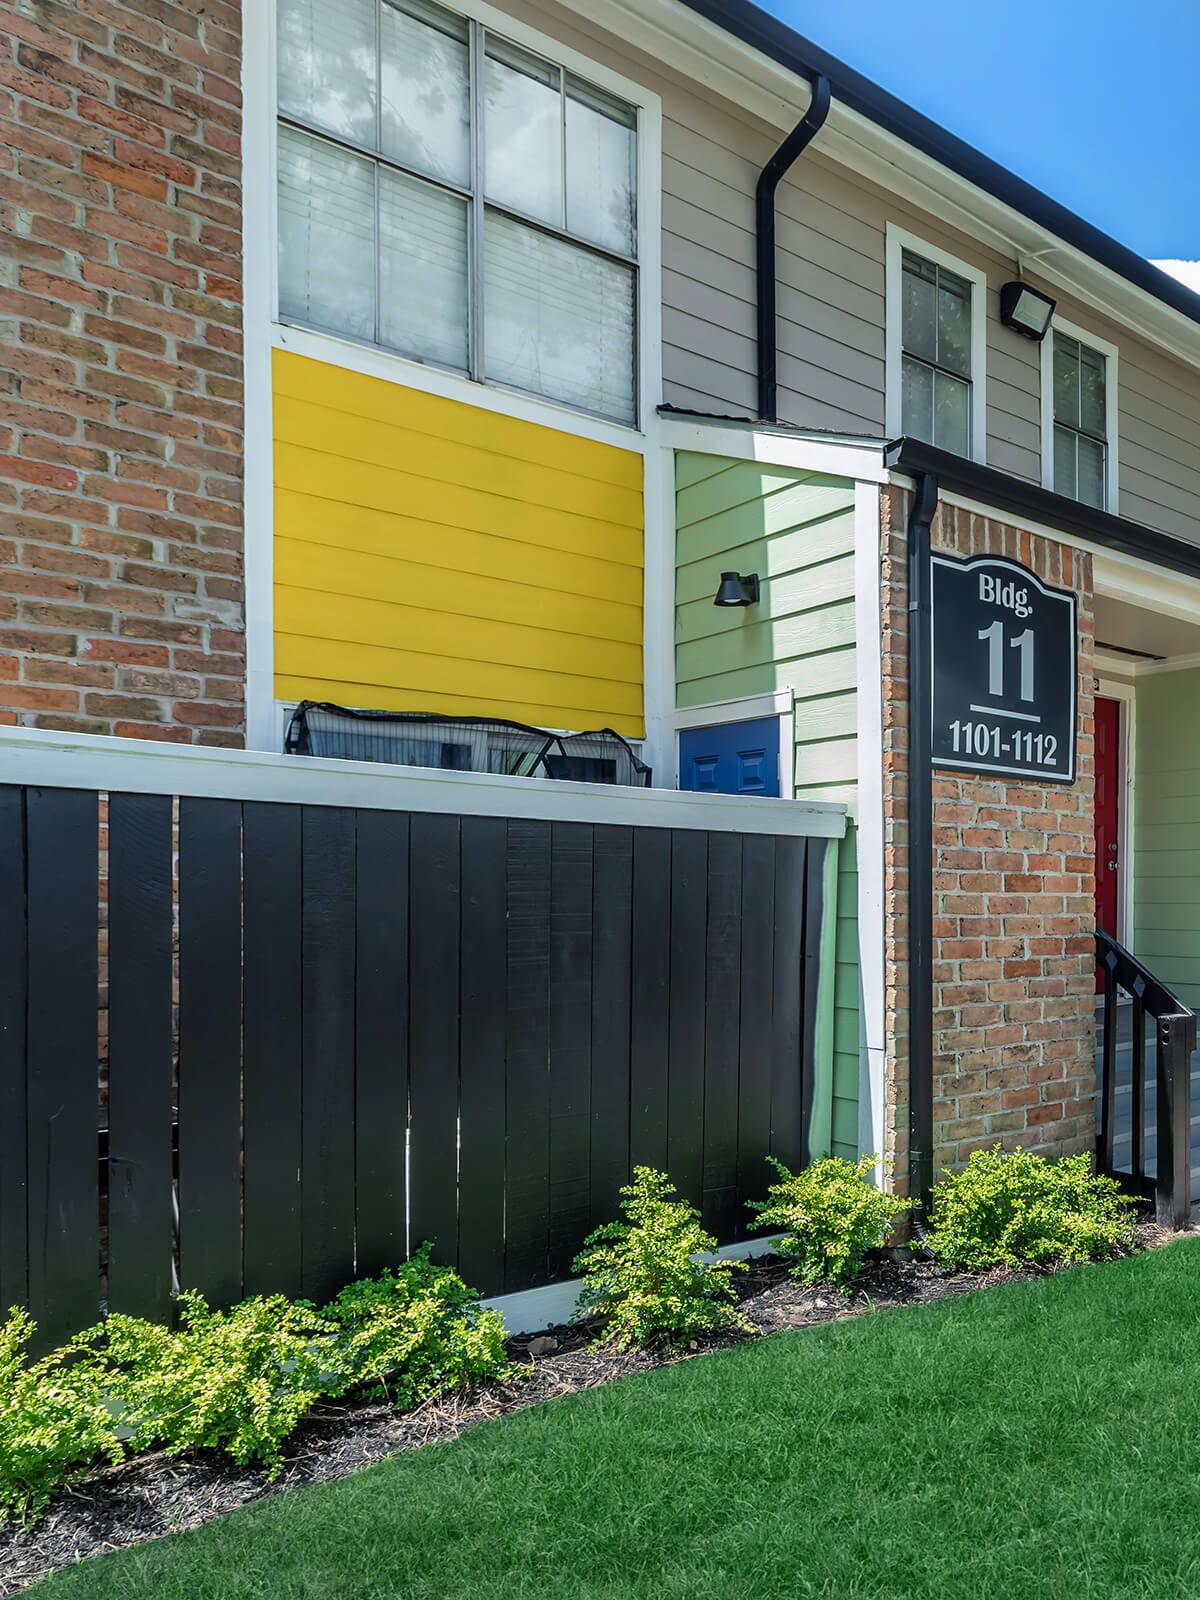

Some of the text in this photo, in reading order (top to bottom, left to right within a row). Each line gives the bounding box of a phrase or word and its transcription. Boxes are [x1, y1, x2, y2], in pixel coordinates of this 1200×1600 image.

[979, 573, 1033, 618] Bldg.
[978, 620, 1034, 702] 11
[949, 720, 1058, 766] 1101-1112
